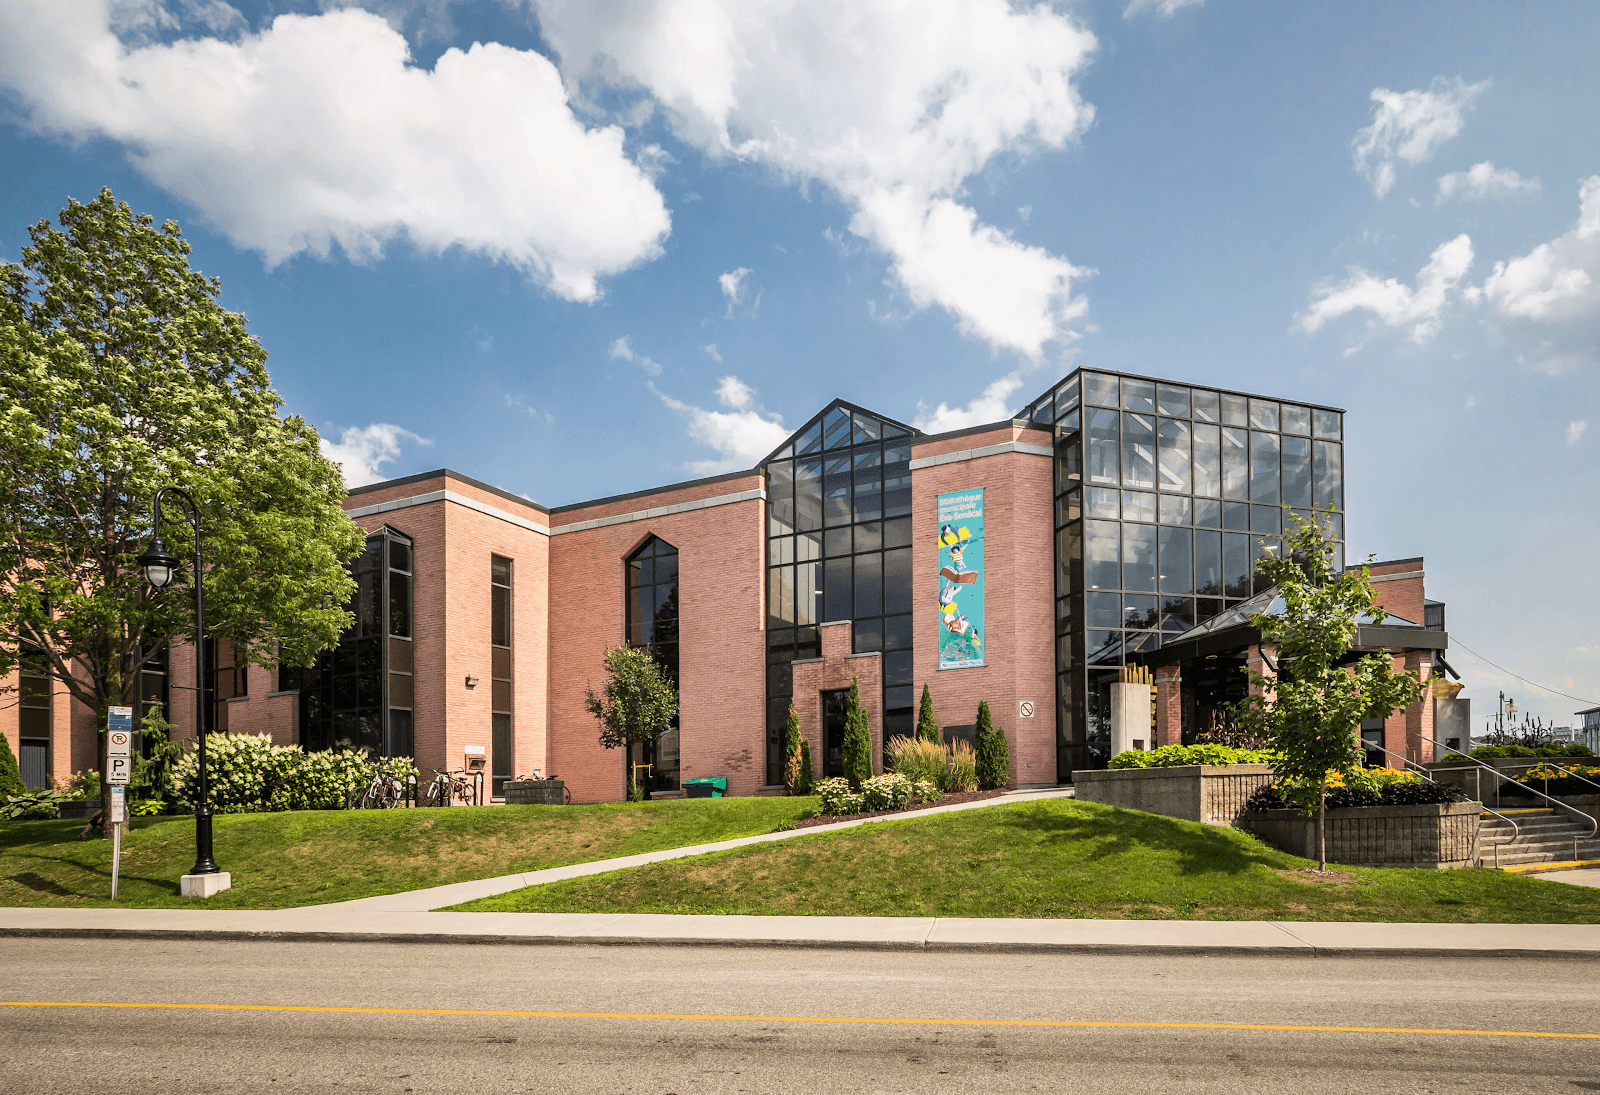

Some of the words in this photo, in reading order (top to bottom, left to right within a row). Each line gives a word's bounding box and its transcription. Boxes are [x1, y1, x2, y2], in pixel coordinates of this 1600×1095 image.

[940, 494, 982, 506] Bibliothèque
[940, 502, 976, 513] municipale
[114, 760, 124, 772] P
